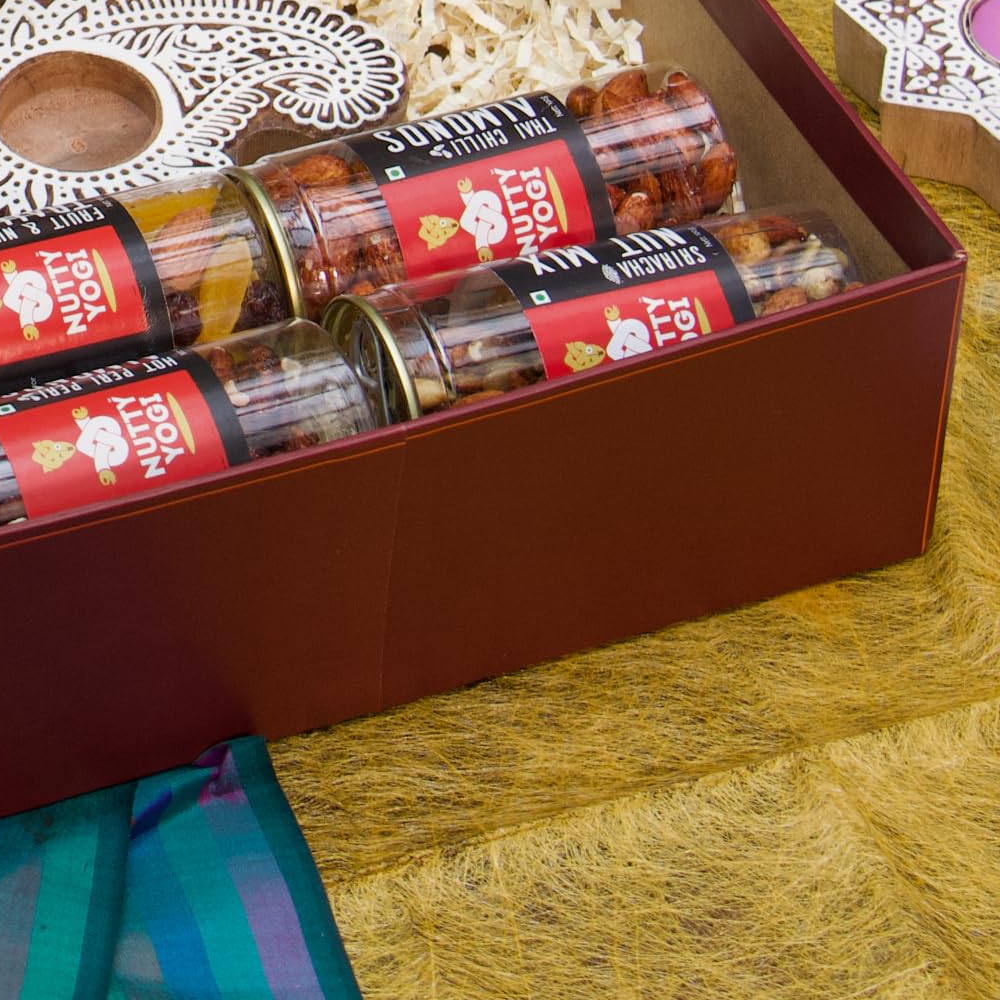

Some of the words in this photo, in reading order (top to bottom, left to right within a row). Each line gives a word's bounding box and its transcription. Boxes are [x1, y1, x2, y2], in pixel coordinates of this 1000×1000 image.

[373, 96, 537, 153] ALMONDS
[514, 116, 557, 140] THAI
[450, 128, 509, 157] CHILLI
[53, 207, 105, 231] FRUIT
[494, 168, 540, 257] NUTTY
[519, 166, 558, 243] YOGI
[22, 221, 42, 236] &
[609, 227, 688, 258] NUT
[516, 245, 600, 276] MIX
[616, 245, 708, 279] SRIRACHA
[40, 250, 88, 335] NUTTY
[65, 248, 107, 323] YOGI
[90, 368, 135, 386] PERI
[144, 355, 178, 374] HOT
[112, 395, 166, 479] NUTTY
[139, 393, 185, 465] YOGI
